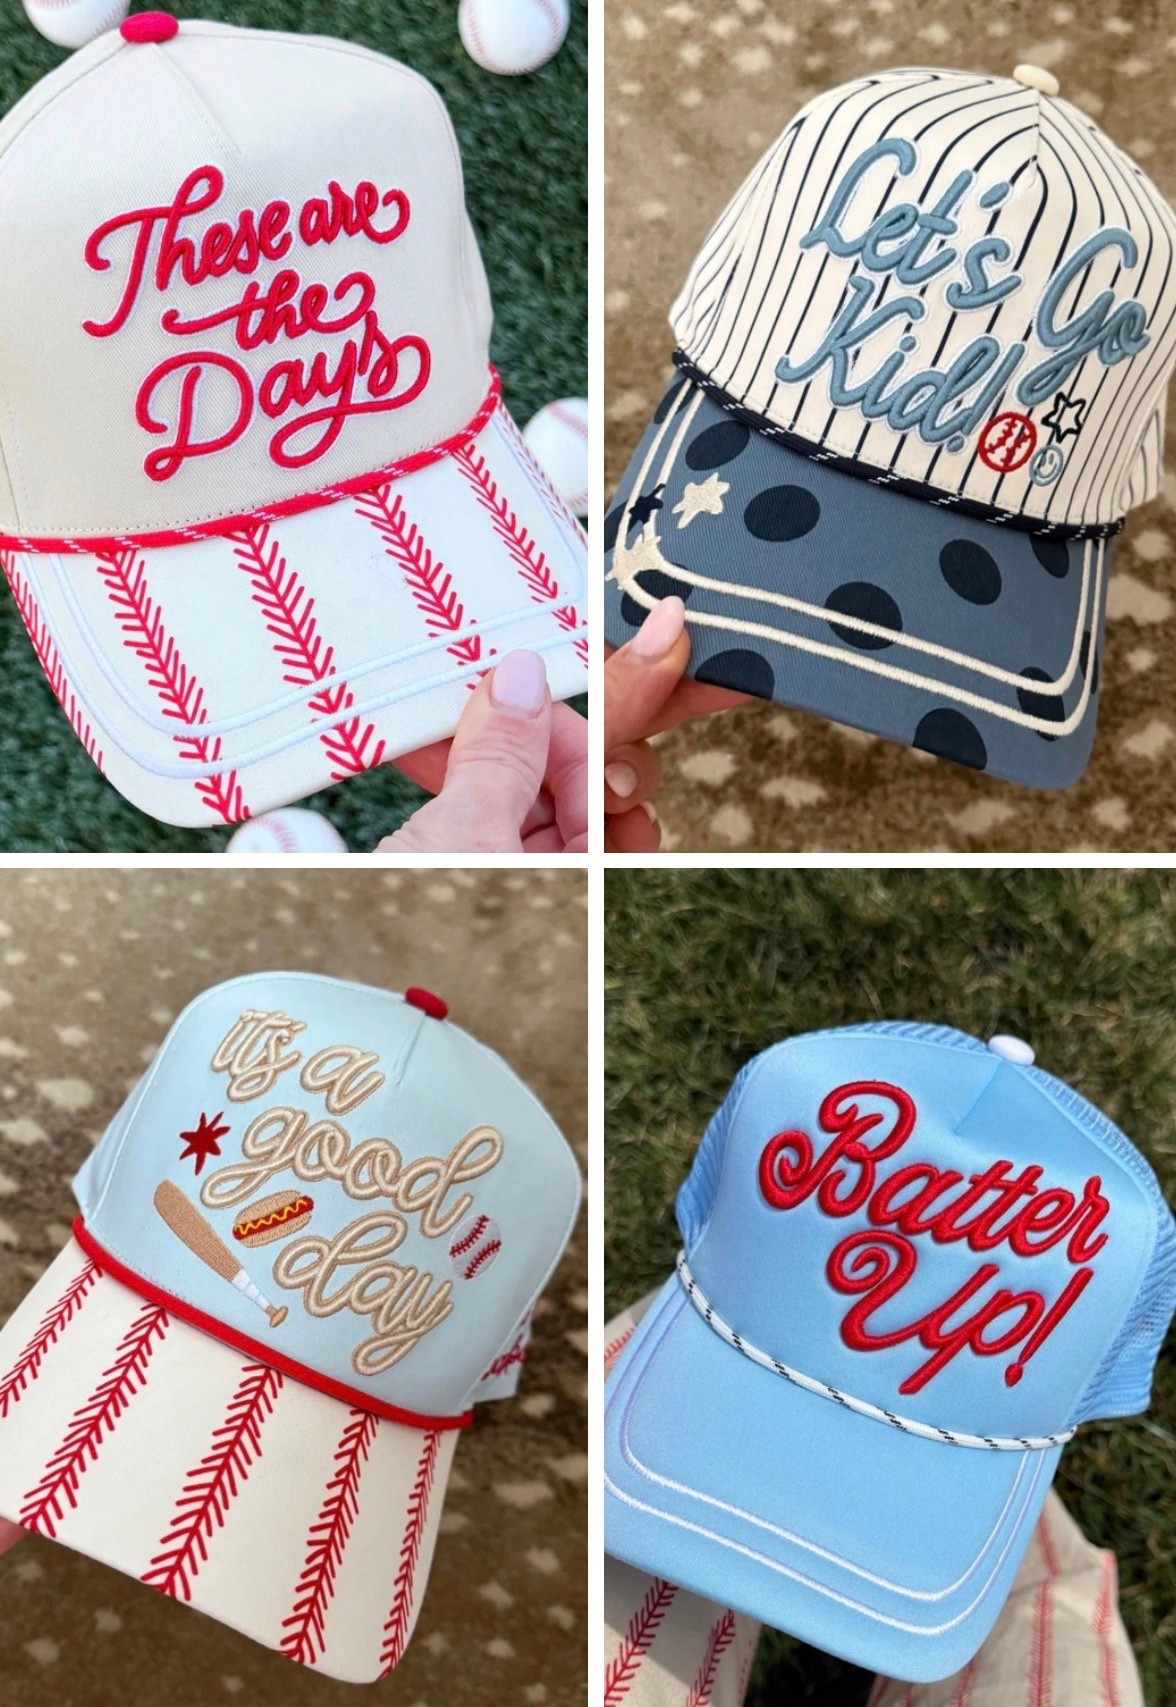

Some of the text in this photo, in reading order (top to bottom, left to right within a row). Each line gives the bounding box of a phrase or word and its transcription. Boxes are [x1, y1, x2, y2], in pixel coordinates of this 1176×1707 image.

[83, 165, 410, 337] These are
[162, 269, 375, 349] the
[800, 138, 1150, 406] Let's Go
[136, 311, 430, 481] Days
[775, 275, 1024, 452] Kid!
[300, 1044, 385, 1115] a
[200, 1106, 503, 1239] good
[758, 1080, 1110, 1264] Batter
[273, 1211, 455, 1376] day
[826, 1231, 1093, 1394] Up!
